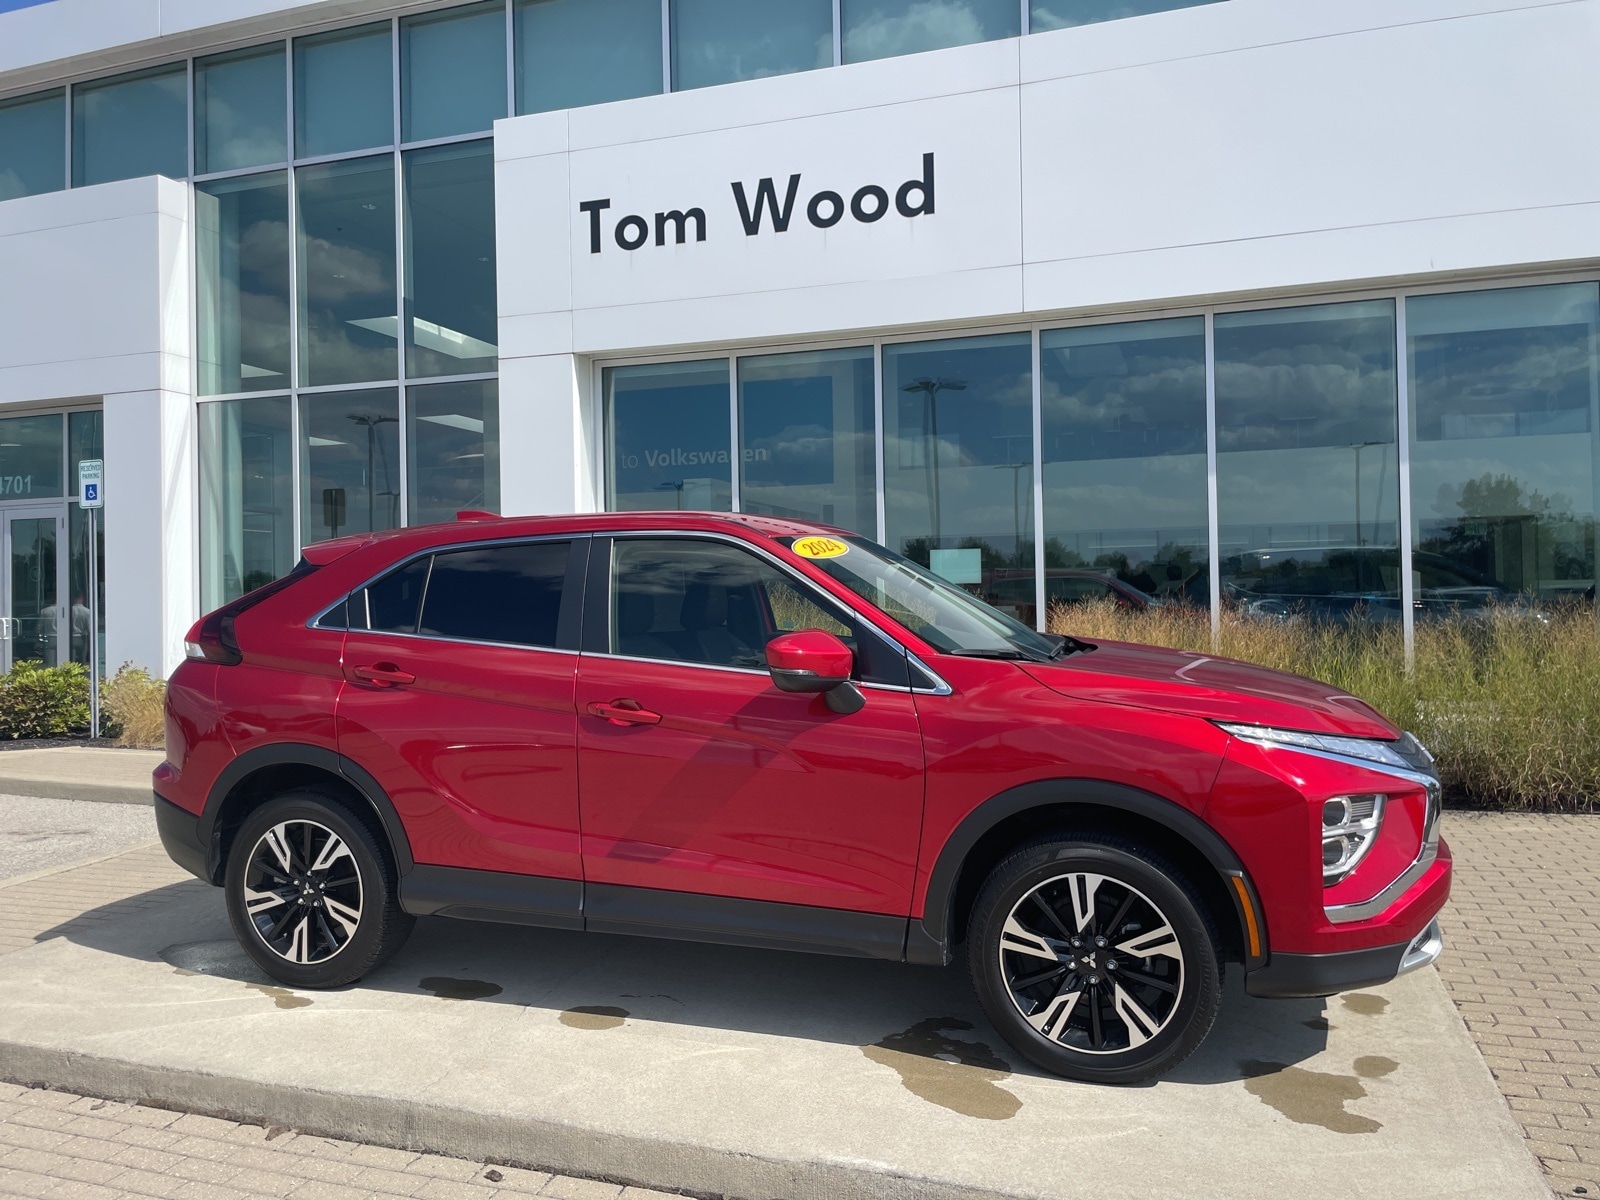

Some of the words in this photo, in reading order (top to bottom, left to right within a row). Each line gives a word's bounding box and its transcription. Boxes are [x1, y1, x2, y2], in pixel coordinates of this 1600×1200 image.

[579, 198, 707, 254] Tom
[730, 151, 936, 237] Wood
[620, 452, 639, 469] to
[644, 447, 767, 468] Volkswaen
[81, 472, 100, 480] PARKING
[802, 539, 842, 556] 2024
